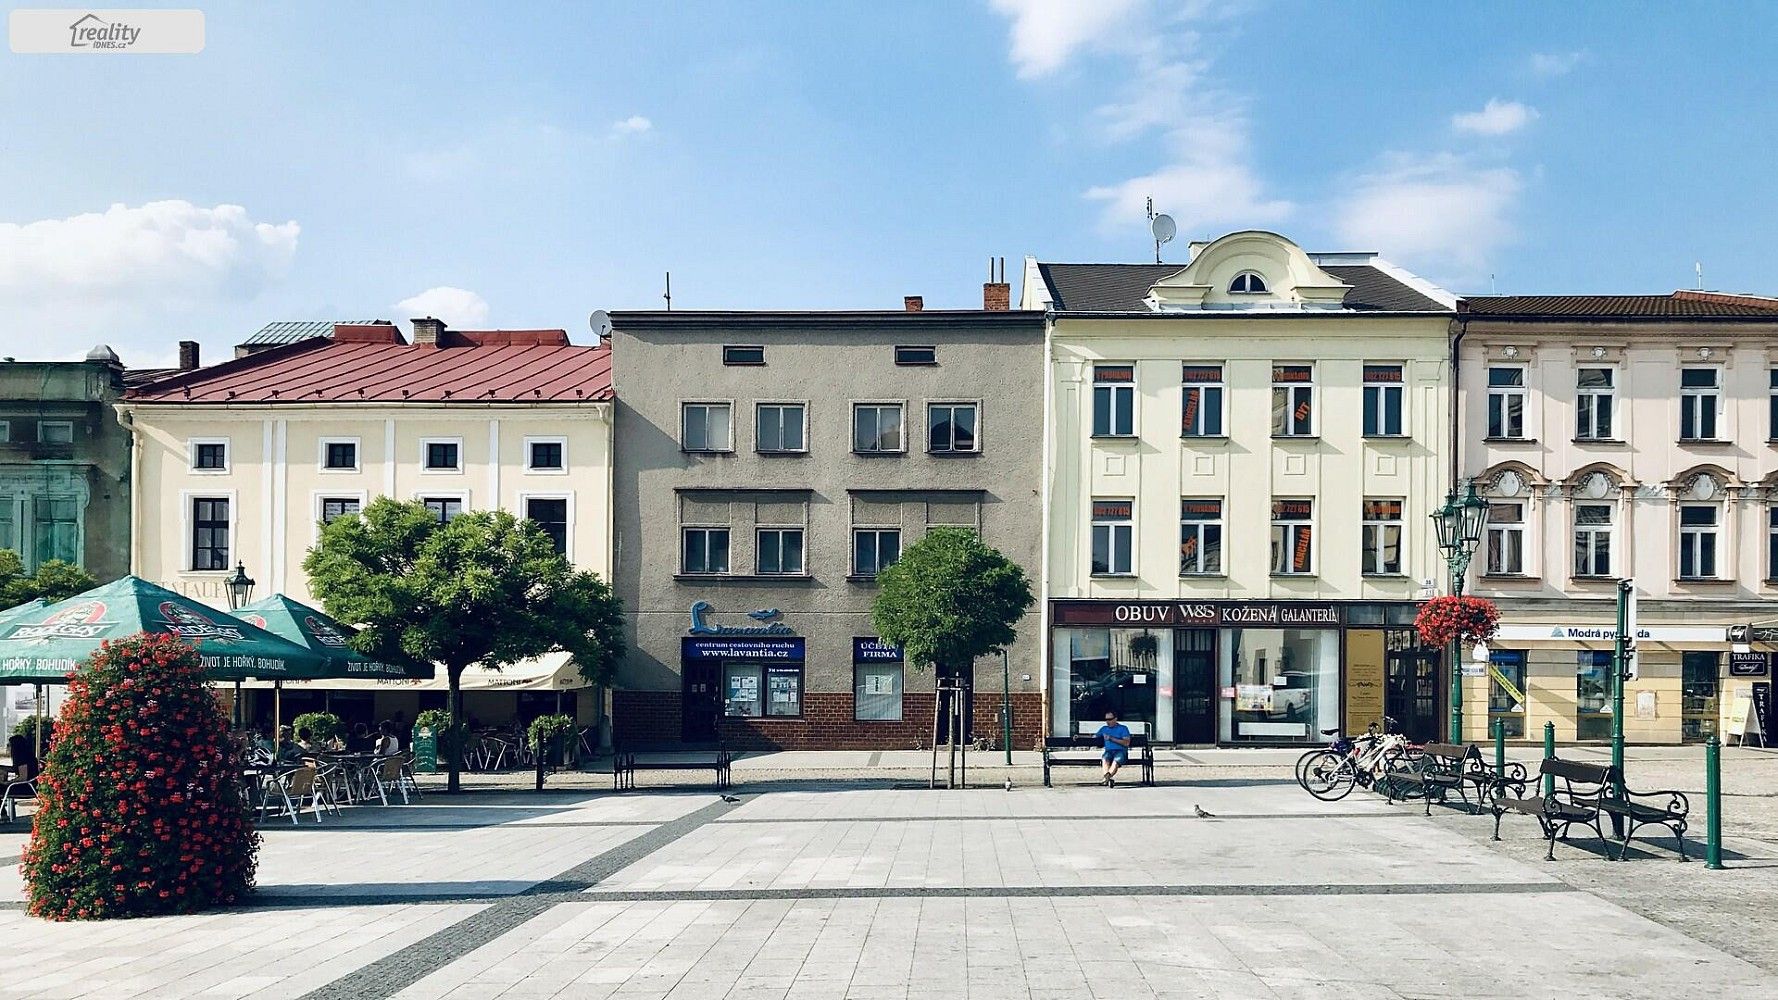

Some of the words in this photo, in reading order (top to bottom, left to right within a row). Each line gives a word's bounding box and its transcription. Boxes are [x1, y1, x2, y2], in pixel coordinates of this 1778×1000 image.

[1115, 606, 1170, 621] OBUV
[1178, 604, 1215, 618] W&S
[1222, 605, 1277, 623] KOŽENÁ
[1568, 628, 1600, 638] Modrá
[1603, 629, 1650, 639] pyda
[702, 648, 788, 657] www.lavantia.cz
